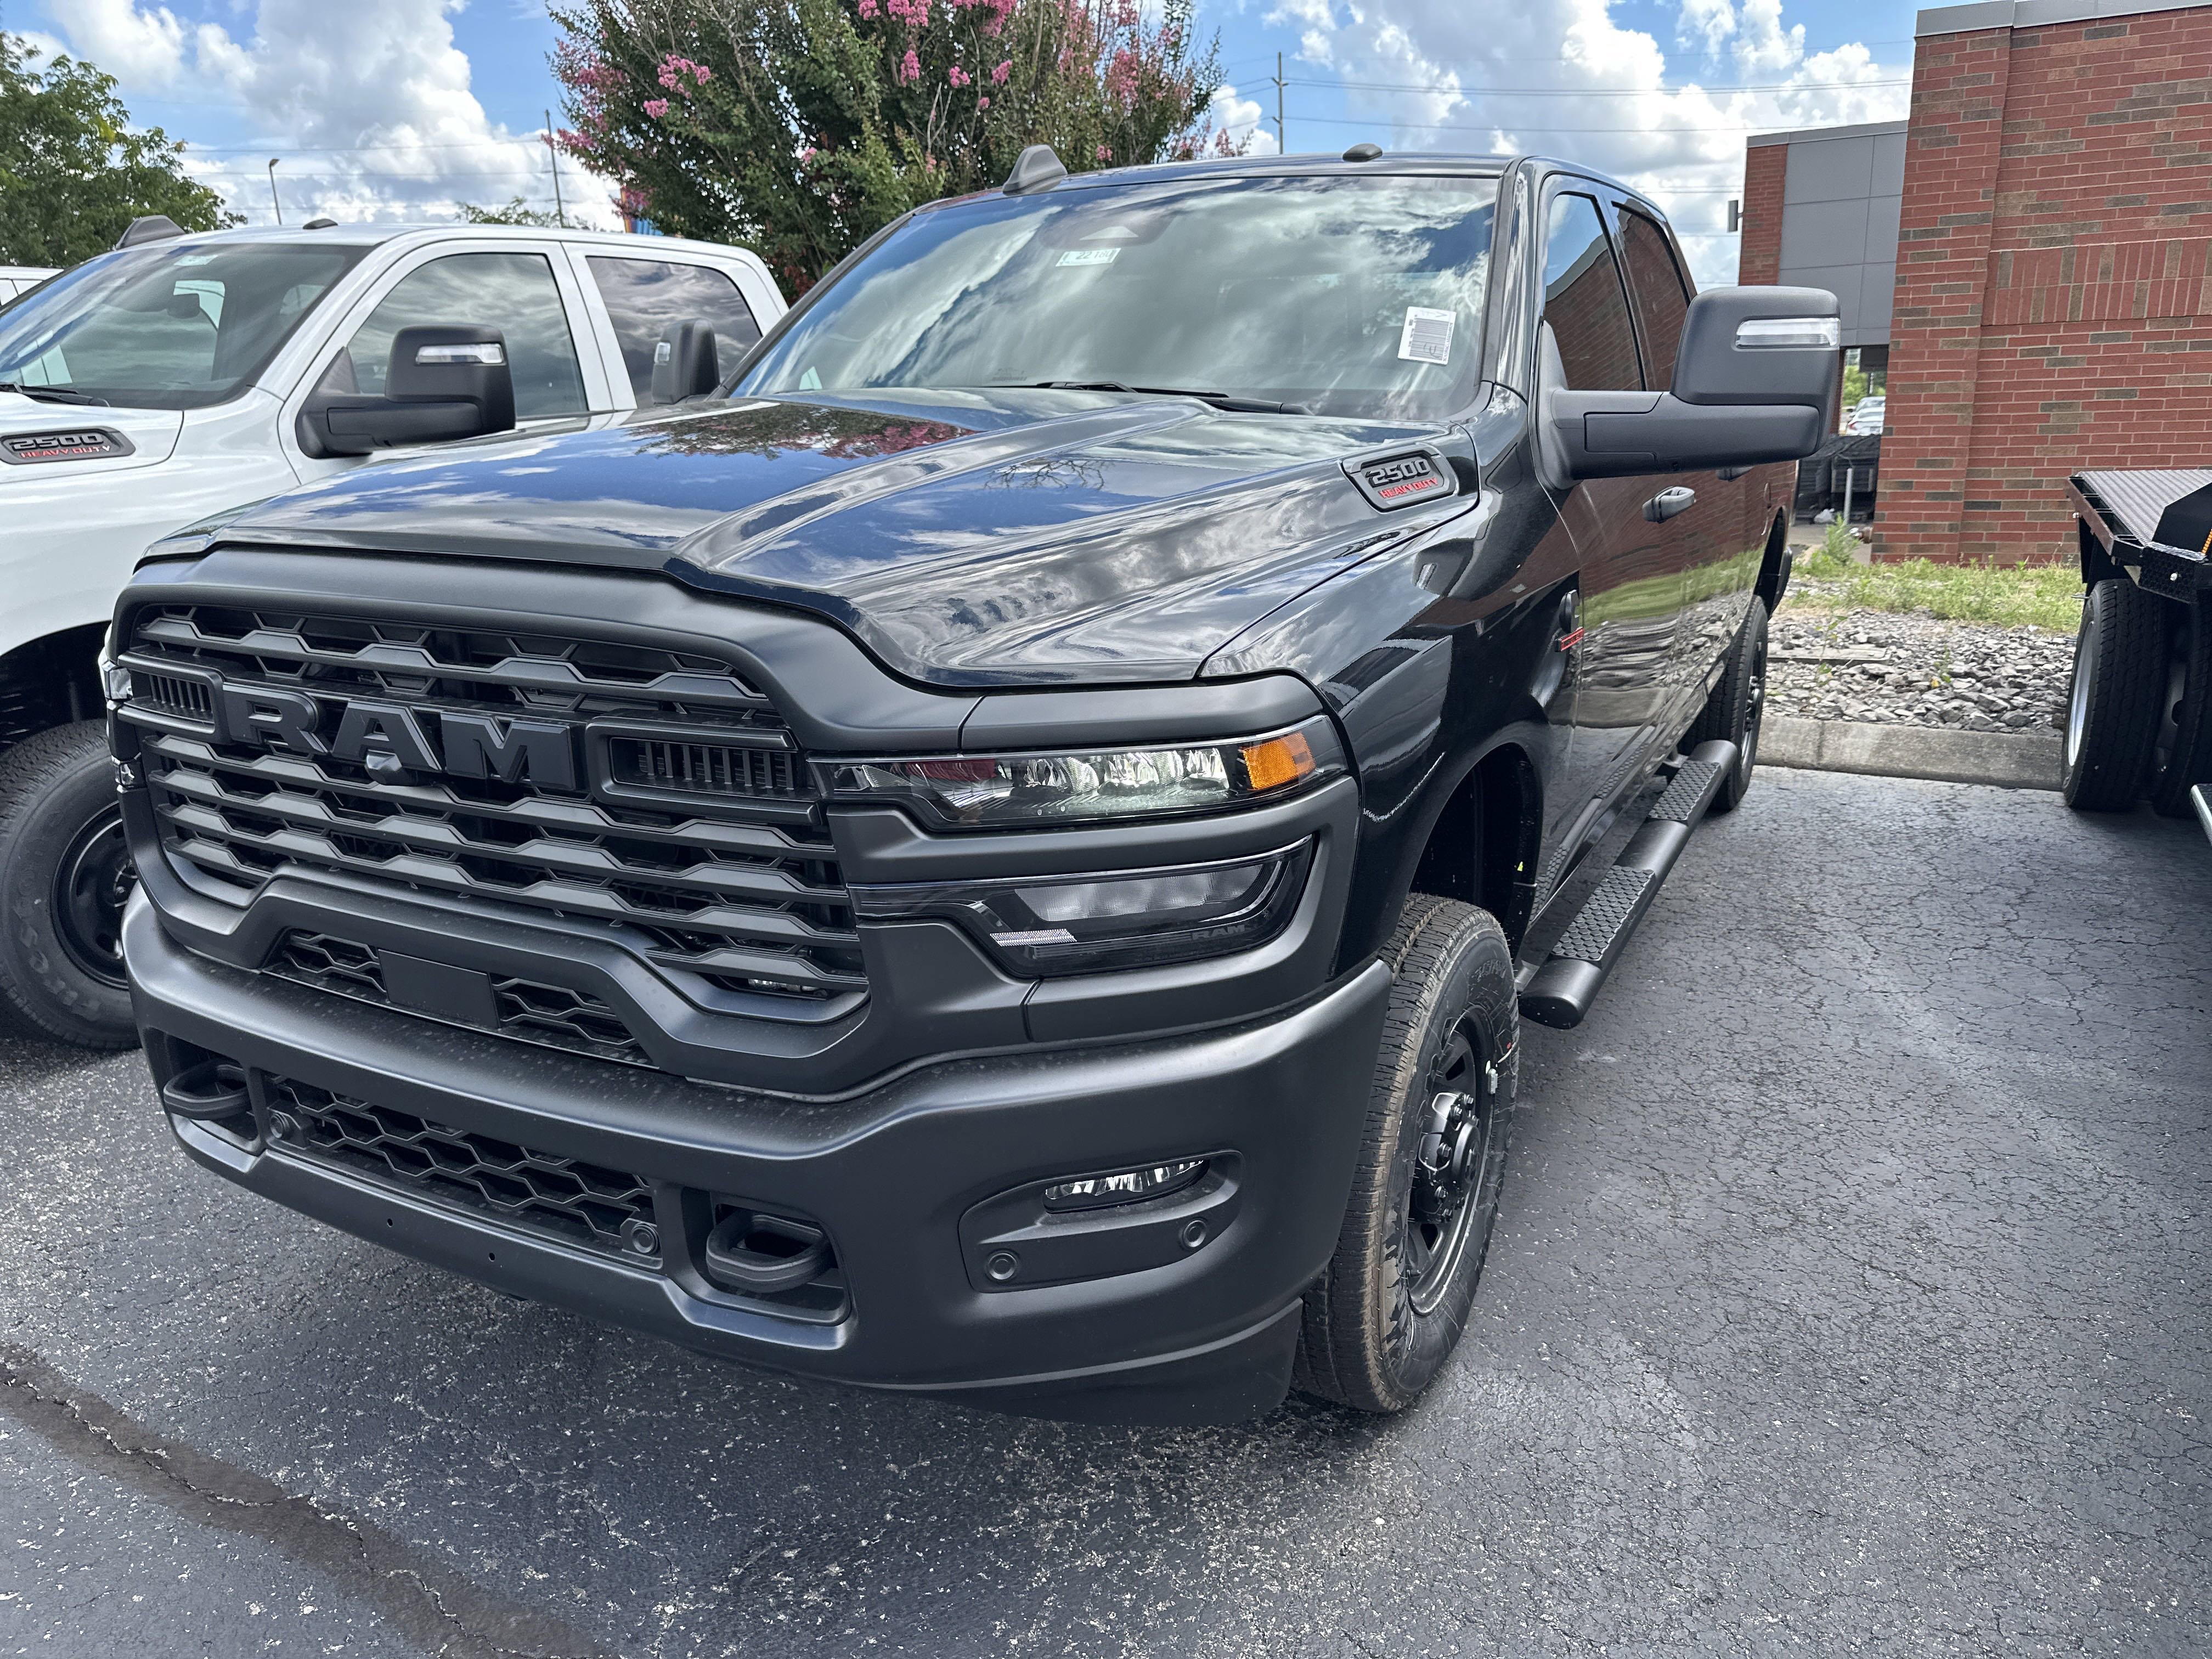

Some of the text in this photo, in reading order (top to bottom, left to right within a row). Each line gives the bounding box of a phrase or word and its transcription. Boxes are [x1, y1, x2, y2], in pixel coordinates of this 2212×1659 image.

[9, 433, 104, 452] 2500
[20, 445, 110, 459] HEAVY DUTY
[1365, 459, 1431, 487] 2500
[1378, 477, 1438, 499] HEAVY DUTY
[222, 682, 576, 790] RAM
[1192, 924, 1246, 940] RAM
